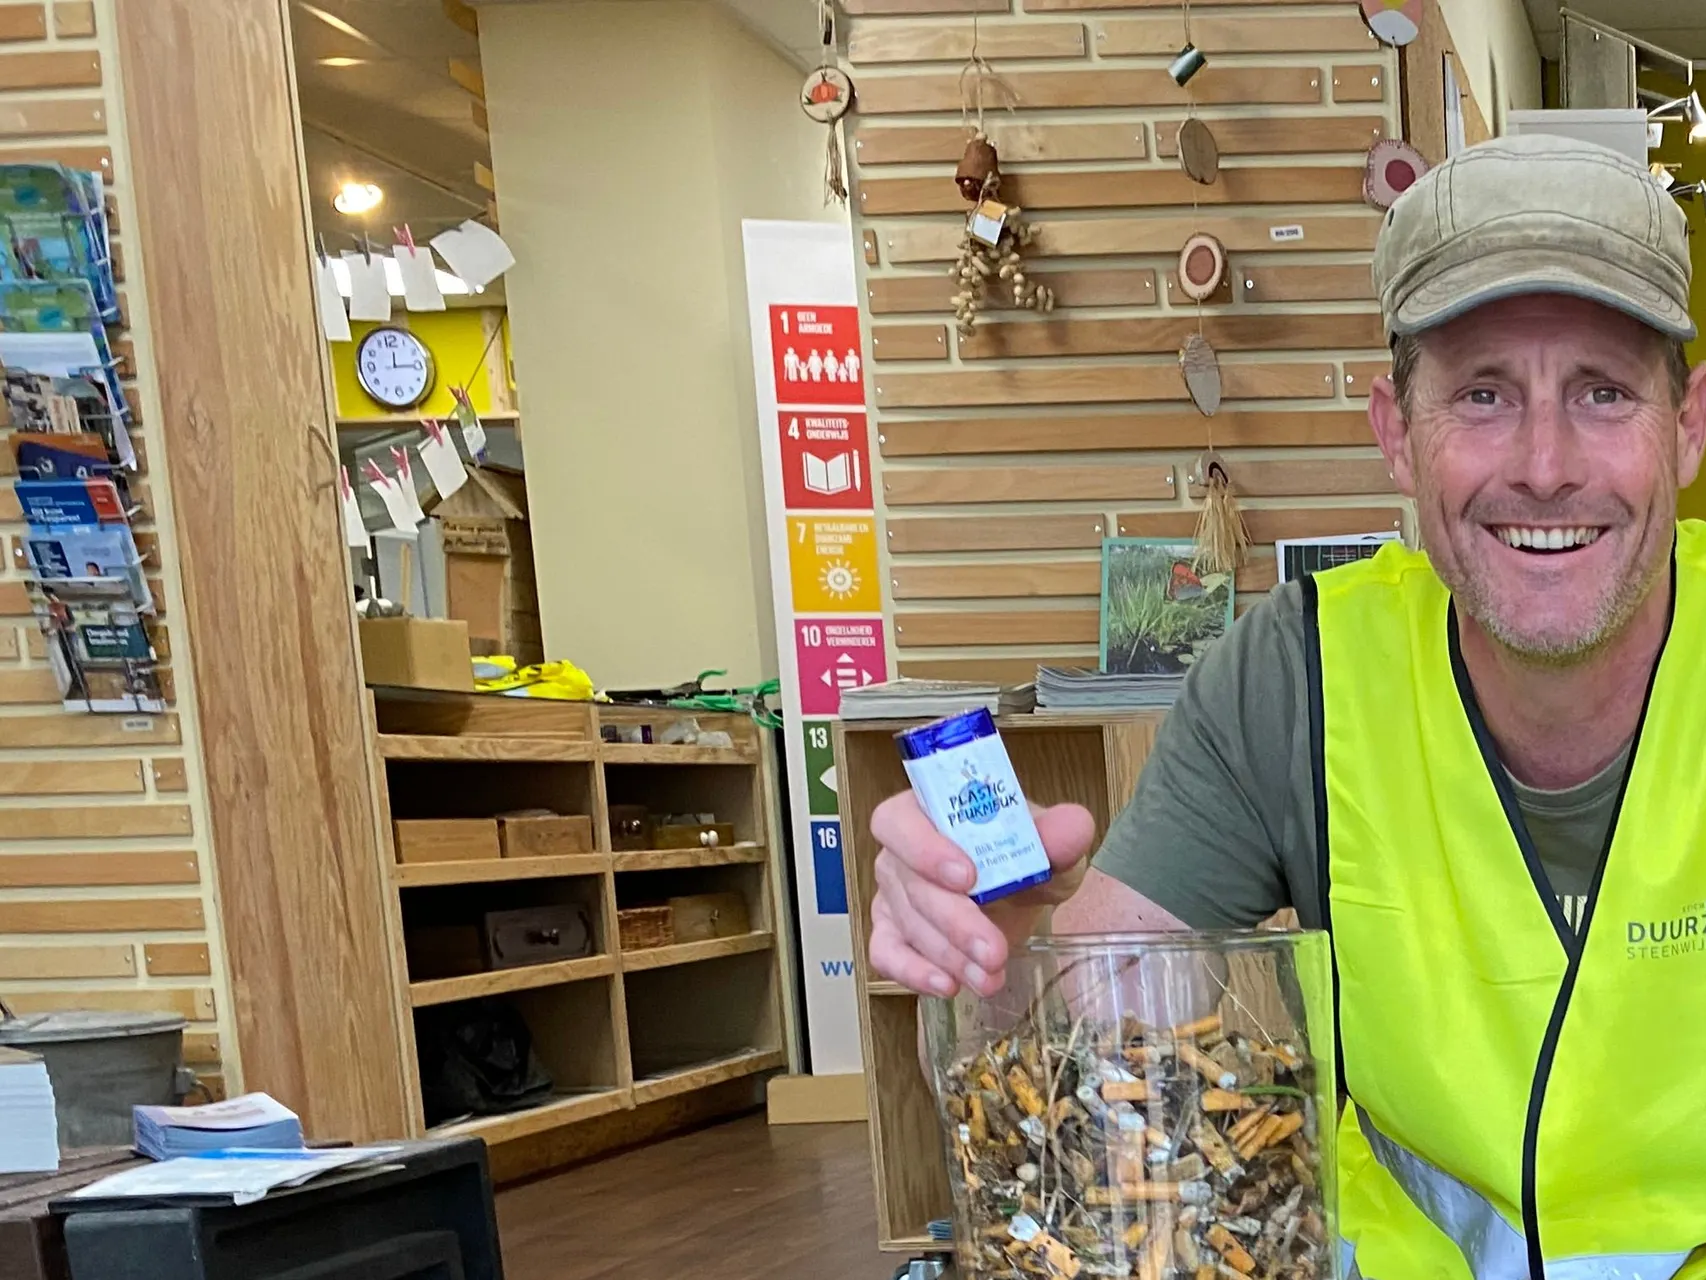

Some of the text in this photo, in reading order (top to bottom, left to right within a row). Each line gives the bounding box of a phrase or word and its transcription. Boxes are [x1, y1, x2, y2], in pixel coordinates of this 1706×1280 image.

[781, 311, 789, 334] 1
[384, 335, 398, 348] 12
[788, 417, 800, 440] 4
[796, 522, 807, 544] 7
[801, 625, 821, 647] 10
[809, 727, 828, 749] 13
[949, 779, 1006, 811] PLASTIC
[817, 827, 838, 849] 16
